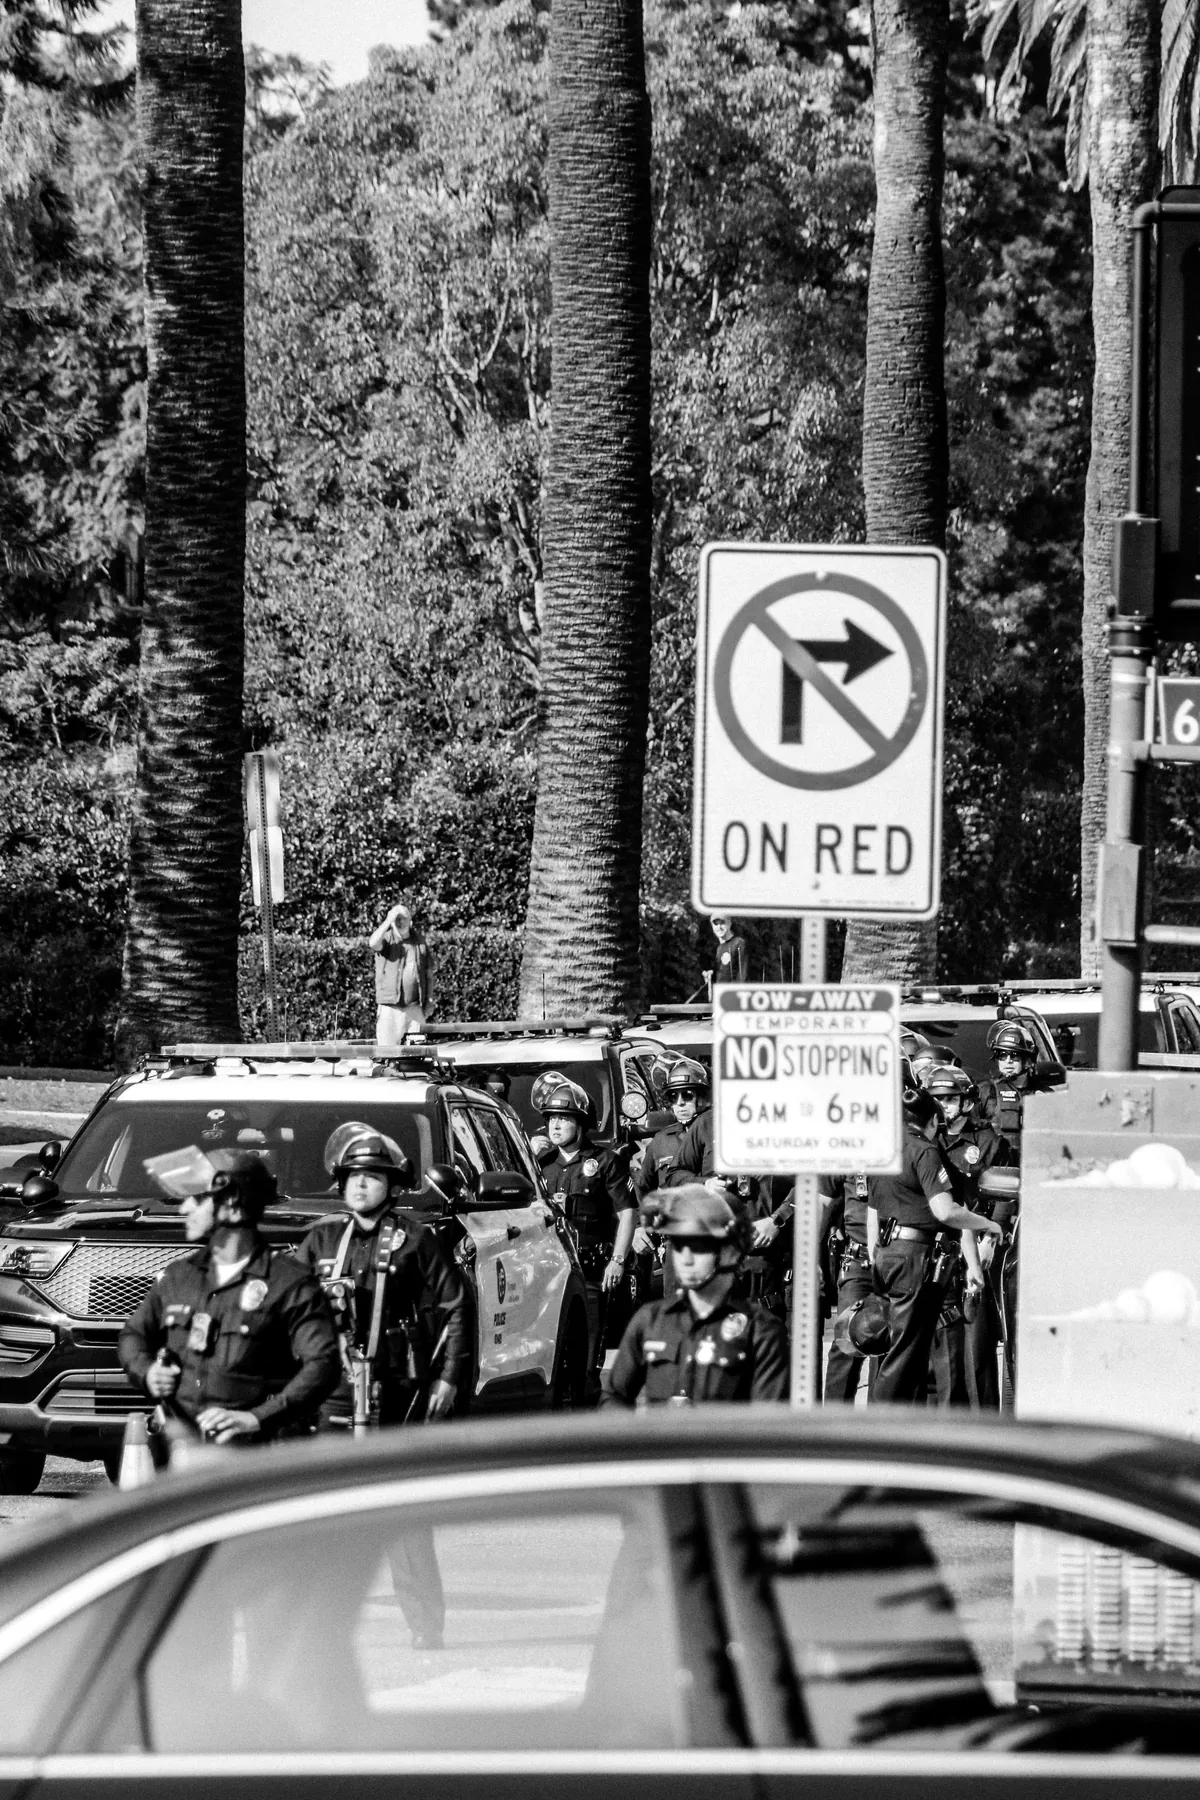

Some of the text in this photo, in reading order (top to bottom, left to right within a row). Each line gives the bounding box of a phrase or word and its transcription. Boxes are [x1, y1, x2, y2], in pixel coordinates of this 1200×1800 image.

[1174, 699, 1199, 744] 6
[723, 820, 912, 875] ON RED
[736, 990, 876, 1010] TOW-AWAY
[744, 1016, 869, 1030] TEMPORARY
[726, 1037, 888, 1079] NO STOPPING
[736, 1093, 787, 1123] 6AM
[827, 1093, 880, 1123] 6PM
[746, 1136, 867, 1150] SATURDAY ONLY
